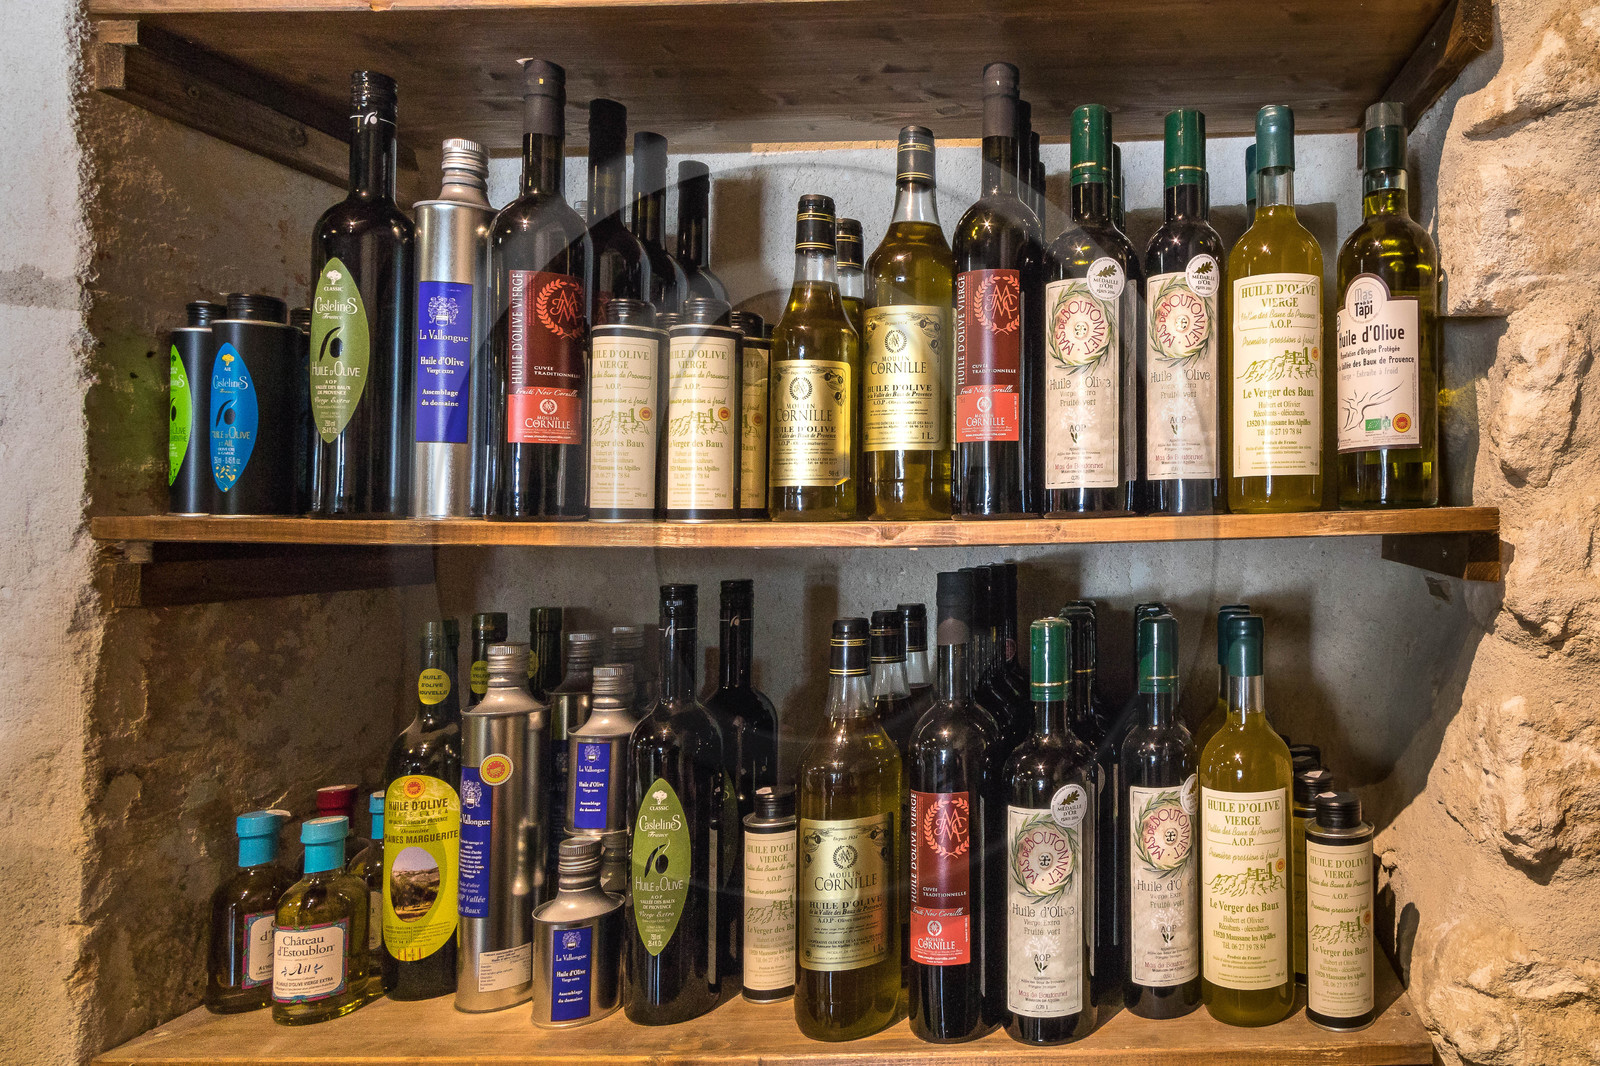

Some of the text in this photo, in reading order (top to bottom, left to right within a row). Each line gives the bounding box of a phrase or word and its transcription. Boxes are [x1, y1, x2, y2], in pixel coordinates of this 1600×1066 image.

[1093, 277, 1119, 285] MÉDAILLE
[1241, 283, 1316, 299] HUILE D'OLIVE
[1354, 288, 1374, 302] Mas
[1261, 297, 1299, 307] VIERGE
[1354, 301, 1374, 319] Tapi
[1156, 294, 1205, 350] MAS DE BOUTONNET
[1268, 319, 1293, 329] A.O.P.
[511, 272, 523, 385] HUILE D'OLIVE VIERGE
[957, 275, 965, 386] HUILE D'OLIVE VIERGE
[1055, 300, 1107, 356] MAS DE BOUTONNET
[419, 329, 469, 344] La Vallongue
[1269, 335, 1297, 347] pression
[1338, 324, 1405, 349] Huile d'Olive
[609, 350, 650, 360] D'OLIVE
[688, 349, 728, 360] D'OLIVE
[1356, 345, 1401, 356] d'Origine Protégée
[420, 356, 465, 367] Huile d'Olive
[599, 360, 629, 370] VIERGE
[678, 360, 708, 369] VIERGE
[1353, 355, 1415, 368] des Baux de Provence
[870, 360, 927, 375] CORNILLE
[1150, 369, 1211, 384] Huile 'Olive
[892, 384, 933, 393] D'OLIVE
[1049, 377, 1072, 391] Huile
[422, 388, 459, 397] Assemblage
[1242, 386, 1314, 399] Le Verger des Baux
[430, 399, 459, 407] domaine
[1283, 400, 1301, 408] Olivier
[775, 408, 834, 423] CORNILLE
[525, 417, 571, 430] CORNILLE
[966, 417, 1006, 427] CORNILLE
[1295, 417, 1312, 428] Alpilles
[1069, 424, 1087, 433] AOP
[626, 439, 645, 449] Baux
[706, 439, 724, 449] Baux
[584, 765, 606, 774] Vallongue
[388, 797, 449, 811] HUILE D'OLIVE
[1057, 804, 1082, 812] MÉDAILLE
[1207, 798, 1280, 813] HUILE D'OLIVE
[461, 813, 491, 828] Vallongue
[1224, 815, 1261, 826] VIERGE
[405, 829, 459, 844] MARGUERITE
[1143, 808, 1190, 861] MAS DE BOUTONNET
[1222, 825, 1281, 837] des Provence
[1231, 837, 1256, 847] A.O.P.
[770, 843, 796, 854] D'OLI
[910, 792, 918, 904] HUILE D'OLIVE VIERGE
[759, 853, 788, 864] VIERGE
[1018, 831, 1069, 887] MAS DE BOUTONNET
[1231, 852, 1259, 864] pression
[1309, 855, 1369, 869] HUILE D'OLIVE
[828, 870, 861, 879] MOULIN
[1324, 870, 1355, 879] VIERGE
[635, 876, 655, 892] HUILE
[814, 873, 878, 892] CORNILLE
[1137, 879, 1162, 892] Huile
[465, 894, 487, 904] Vallée
[1331, 892, 1349, 900] A.O.P.
[809, 894, 883, 910] HUILE D'OLIVE
[1150, 900, 1171, 909] Fruité
[1209, 898, 1280, 915] Le Verger des Baux
[464, 906, 482, 914] Baux
[923, 907, 964, 918] Noir Cornille
[1012, 903, 1035, 918] Huile
[1330, 906, 1354, 915] pression
[1223, 915, 1265, 924] Hubert Olivier
[753, 924, 786, 936] Verger des
[1023, 928, 1061, 936] Fruité vert
[1160, 925, 1177, 933] AOP
[282, 935, 324, 947] Château
[1213, 930, 1277, 942] 13520 Maussane Alpilles
[917, 938, 956, 950] CORNILLE
[277, 944, 334, 958] d'Estoublon
[1312, 943, 1370, 958] Le Verger des Baux
[562, 953, 587, 962] Vallongue
[1033, 953, 1052, 962] AOP
[288, 962, 312, 977] Ail
[569, 968, 586, 977] d'Olive
[319, 977, 335, 985] EXTRA
[1018, 989, 1029, 997] Mas
